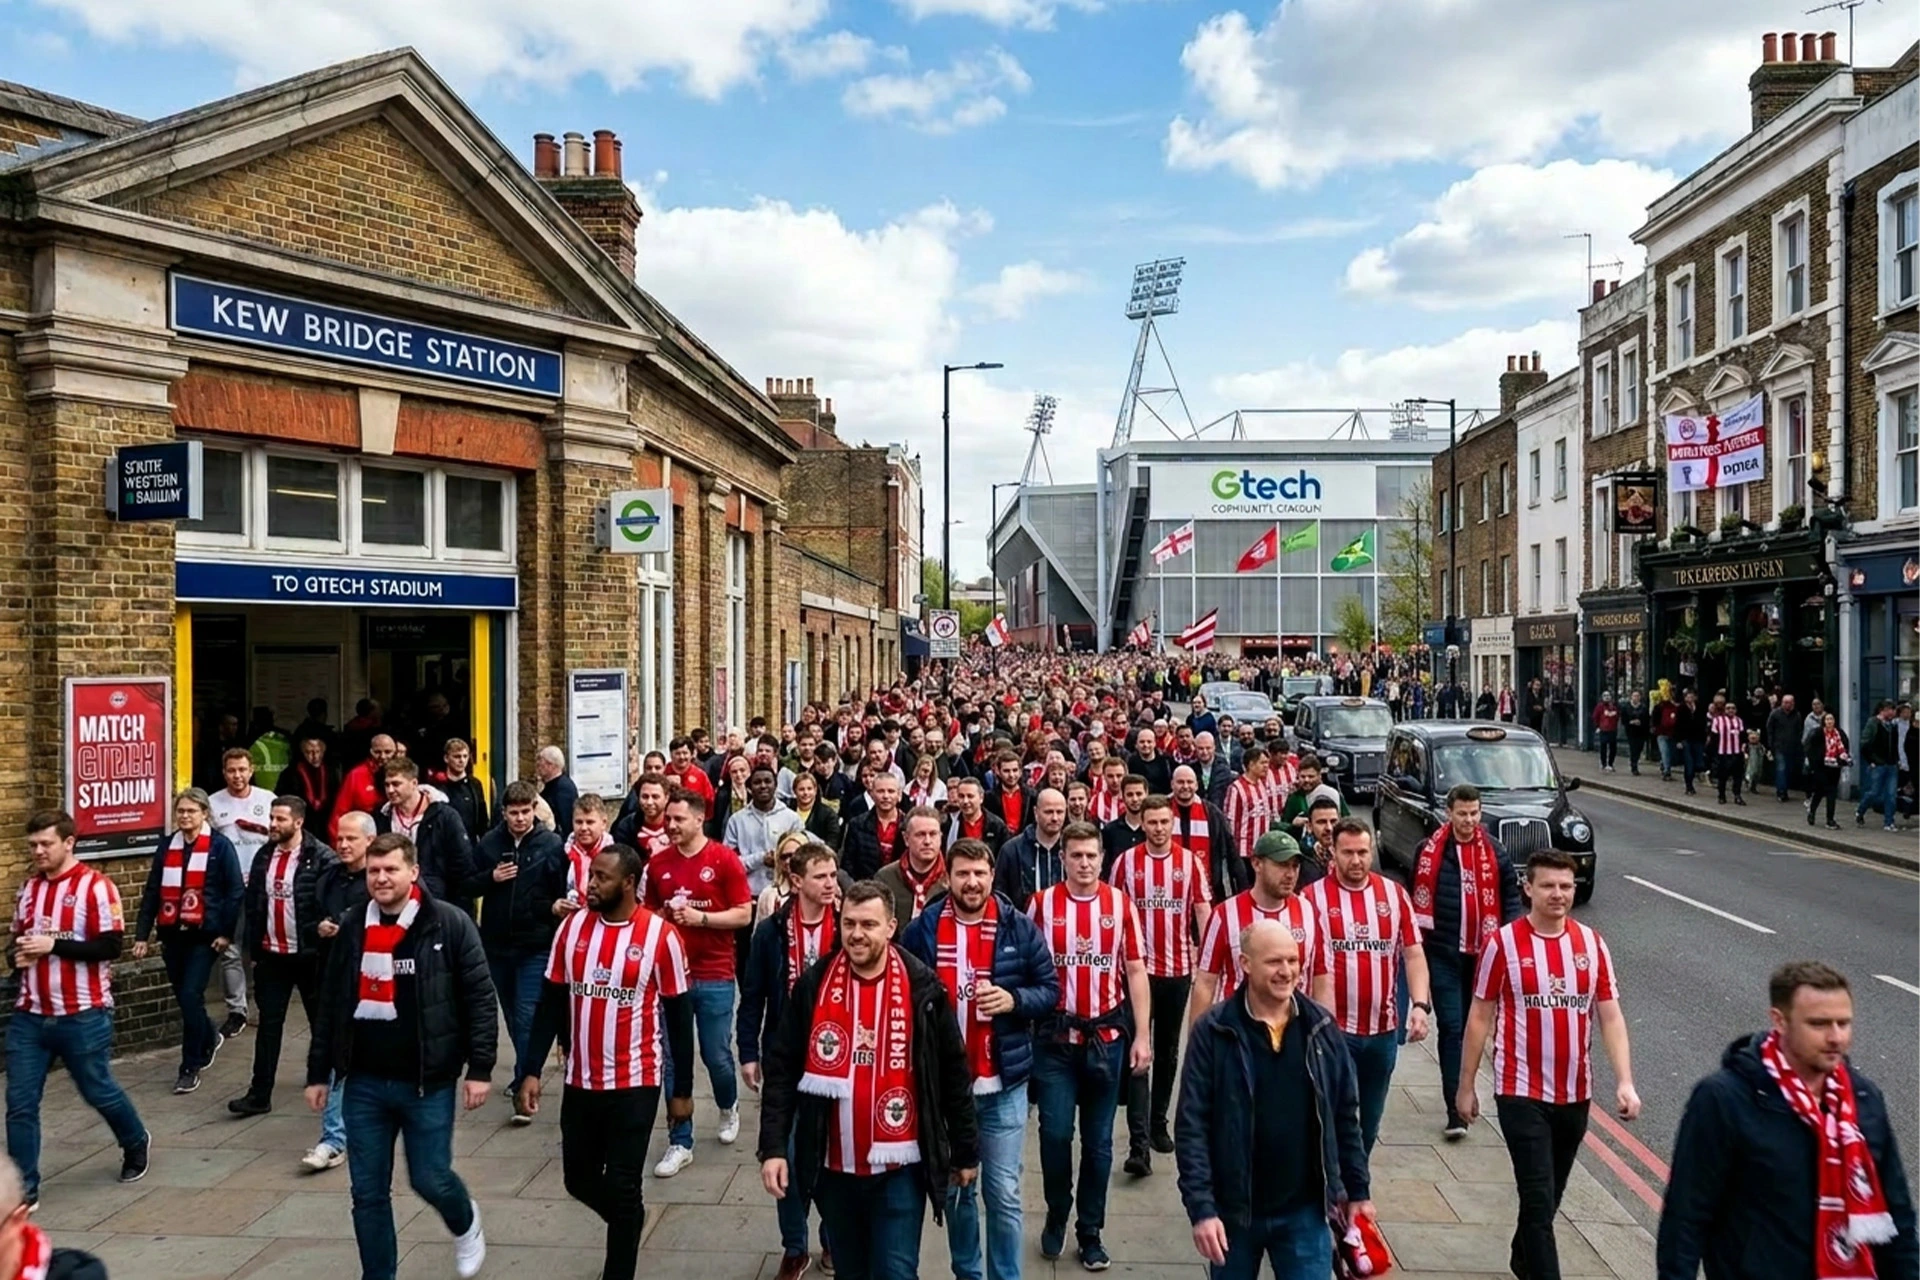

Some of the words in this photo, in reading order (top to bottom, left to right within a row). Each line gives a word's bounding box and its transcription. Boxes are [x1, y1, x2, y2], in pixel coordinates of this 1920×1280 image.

[213, 295, 289, 336] KEW
[304, 313, 412, 360] BRIDGE
[427, 338, 536, 382] STATION
[1211, 469, 1321, 500] Gtech
[272, 575, 299, 592] TO
[304, 576, 364, 595] GTECH
[370, 579, 443, 598] STADIUM
[79, 714, 146, 744] MATCH
[78, 778, 156, 809] STADIUM
